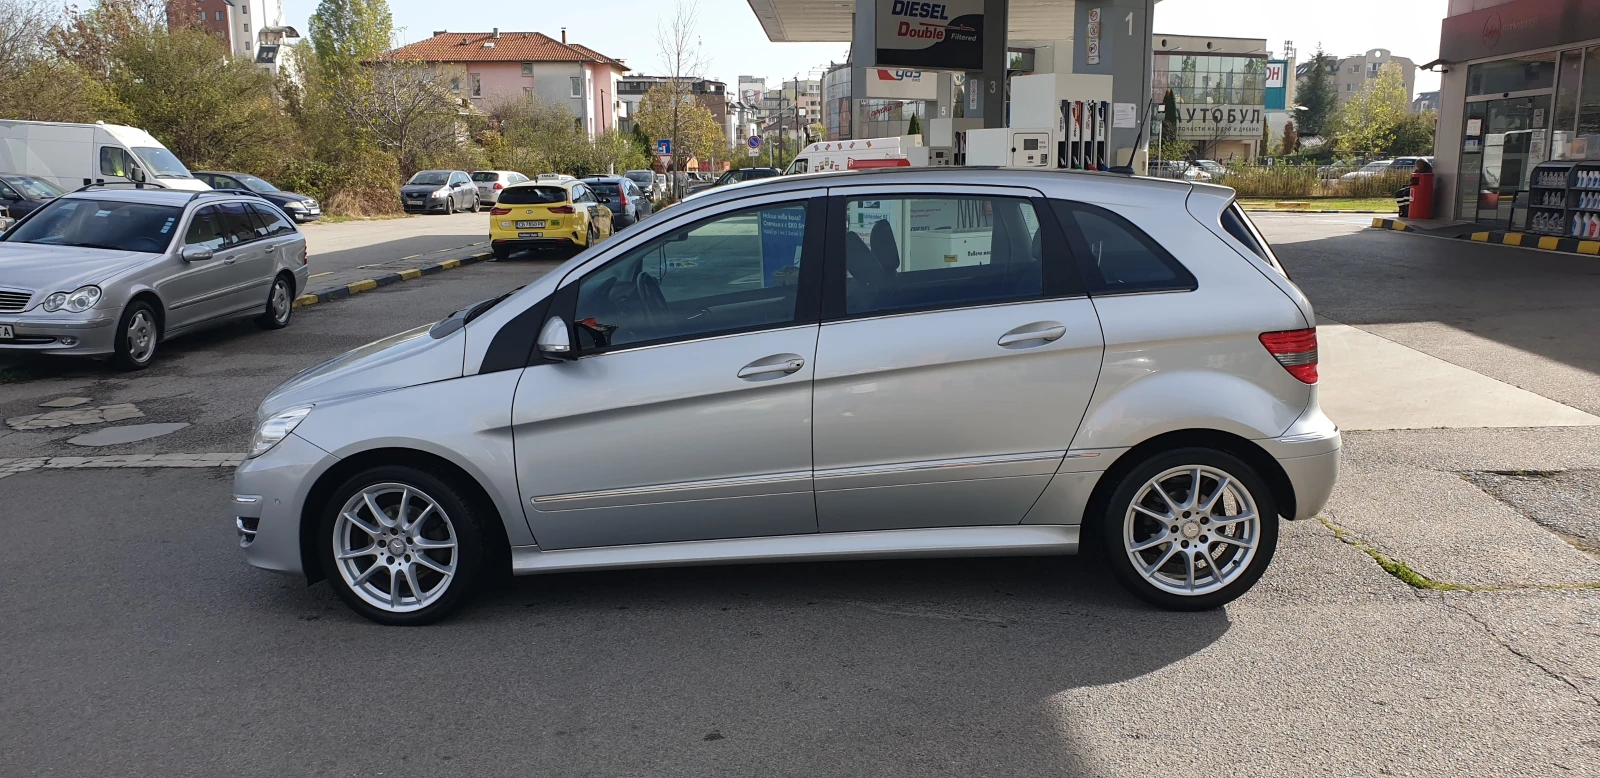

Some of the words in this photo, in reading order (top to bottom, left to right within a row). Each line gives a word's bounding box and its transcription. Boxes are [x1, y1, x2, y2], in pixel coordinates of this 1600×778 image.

[892, 0, 948, 20] DIESEL
[898, 21, 943, 39] Double
[1125, 11, 1133, 36] 1
[951, 33, 976, 41] Filtered
[990, 80, 996, 94] 3
[941, 106, 946, 116] 5
